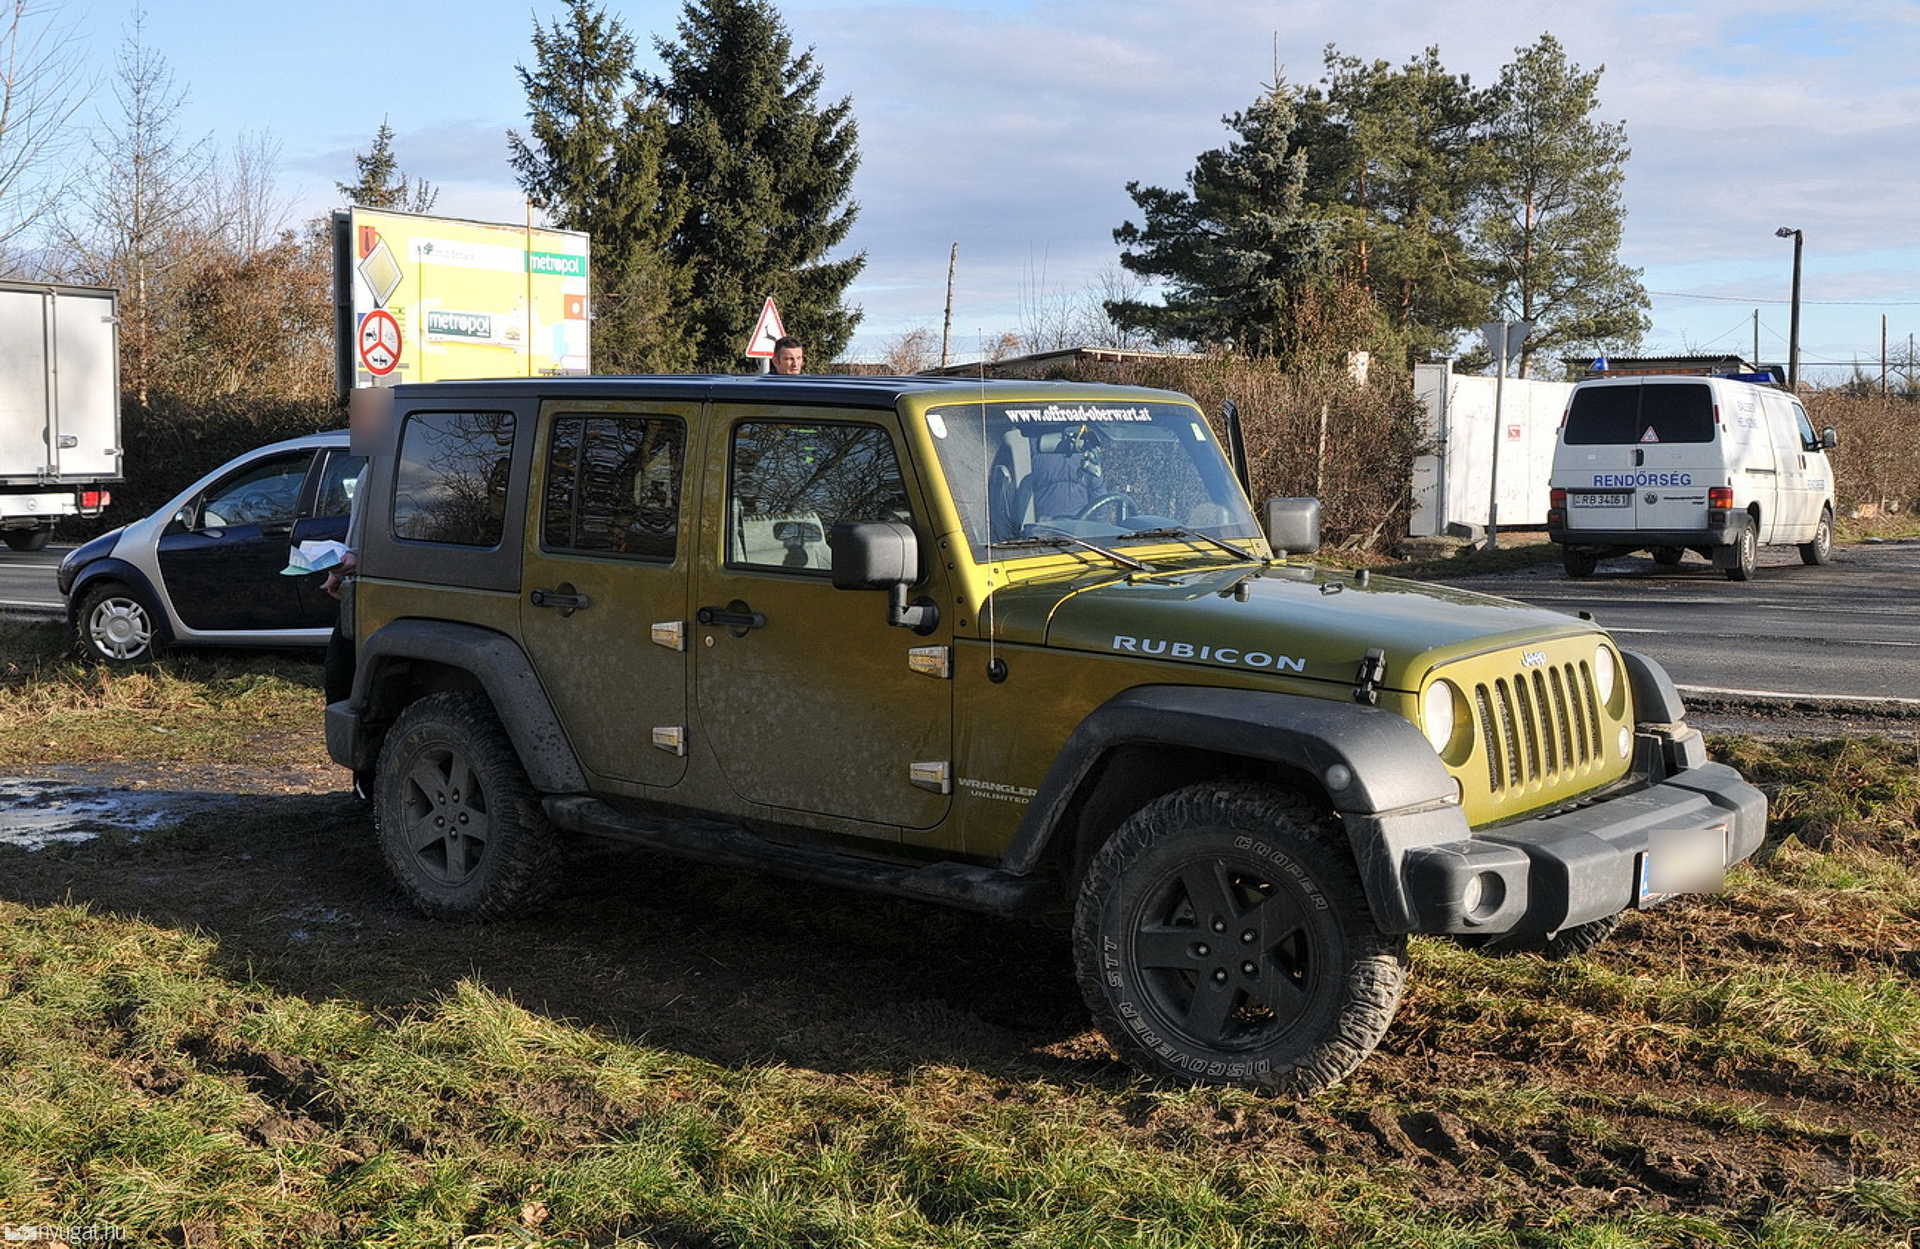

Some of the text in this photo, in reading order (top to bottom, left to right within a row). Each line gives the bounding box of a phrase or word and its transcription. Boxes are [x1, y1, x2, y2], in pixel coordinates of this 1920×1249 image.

[529, 254, 579, 274] metropol
[429, 313, 490, 335] metropol
[1005, 405, 1152, 422] www.offroad-oberwart.at
[1593, 470, 1692, 487] RENDŐRSÉG
[1112, 635, 1306, 672] RUBICON
[958, 777, 1038, 797] WRANGLER
[970, 790, 1030, 804] UNLIMITED
[1233, 835, 1328, 910] COOPER
[1103, 935, 1123, 989] STT
[1118, 1001, 1271, 1078] DISCOVERER
